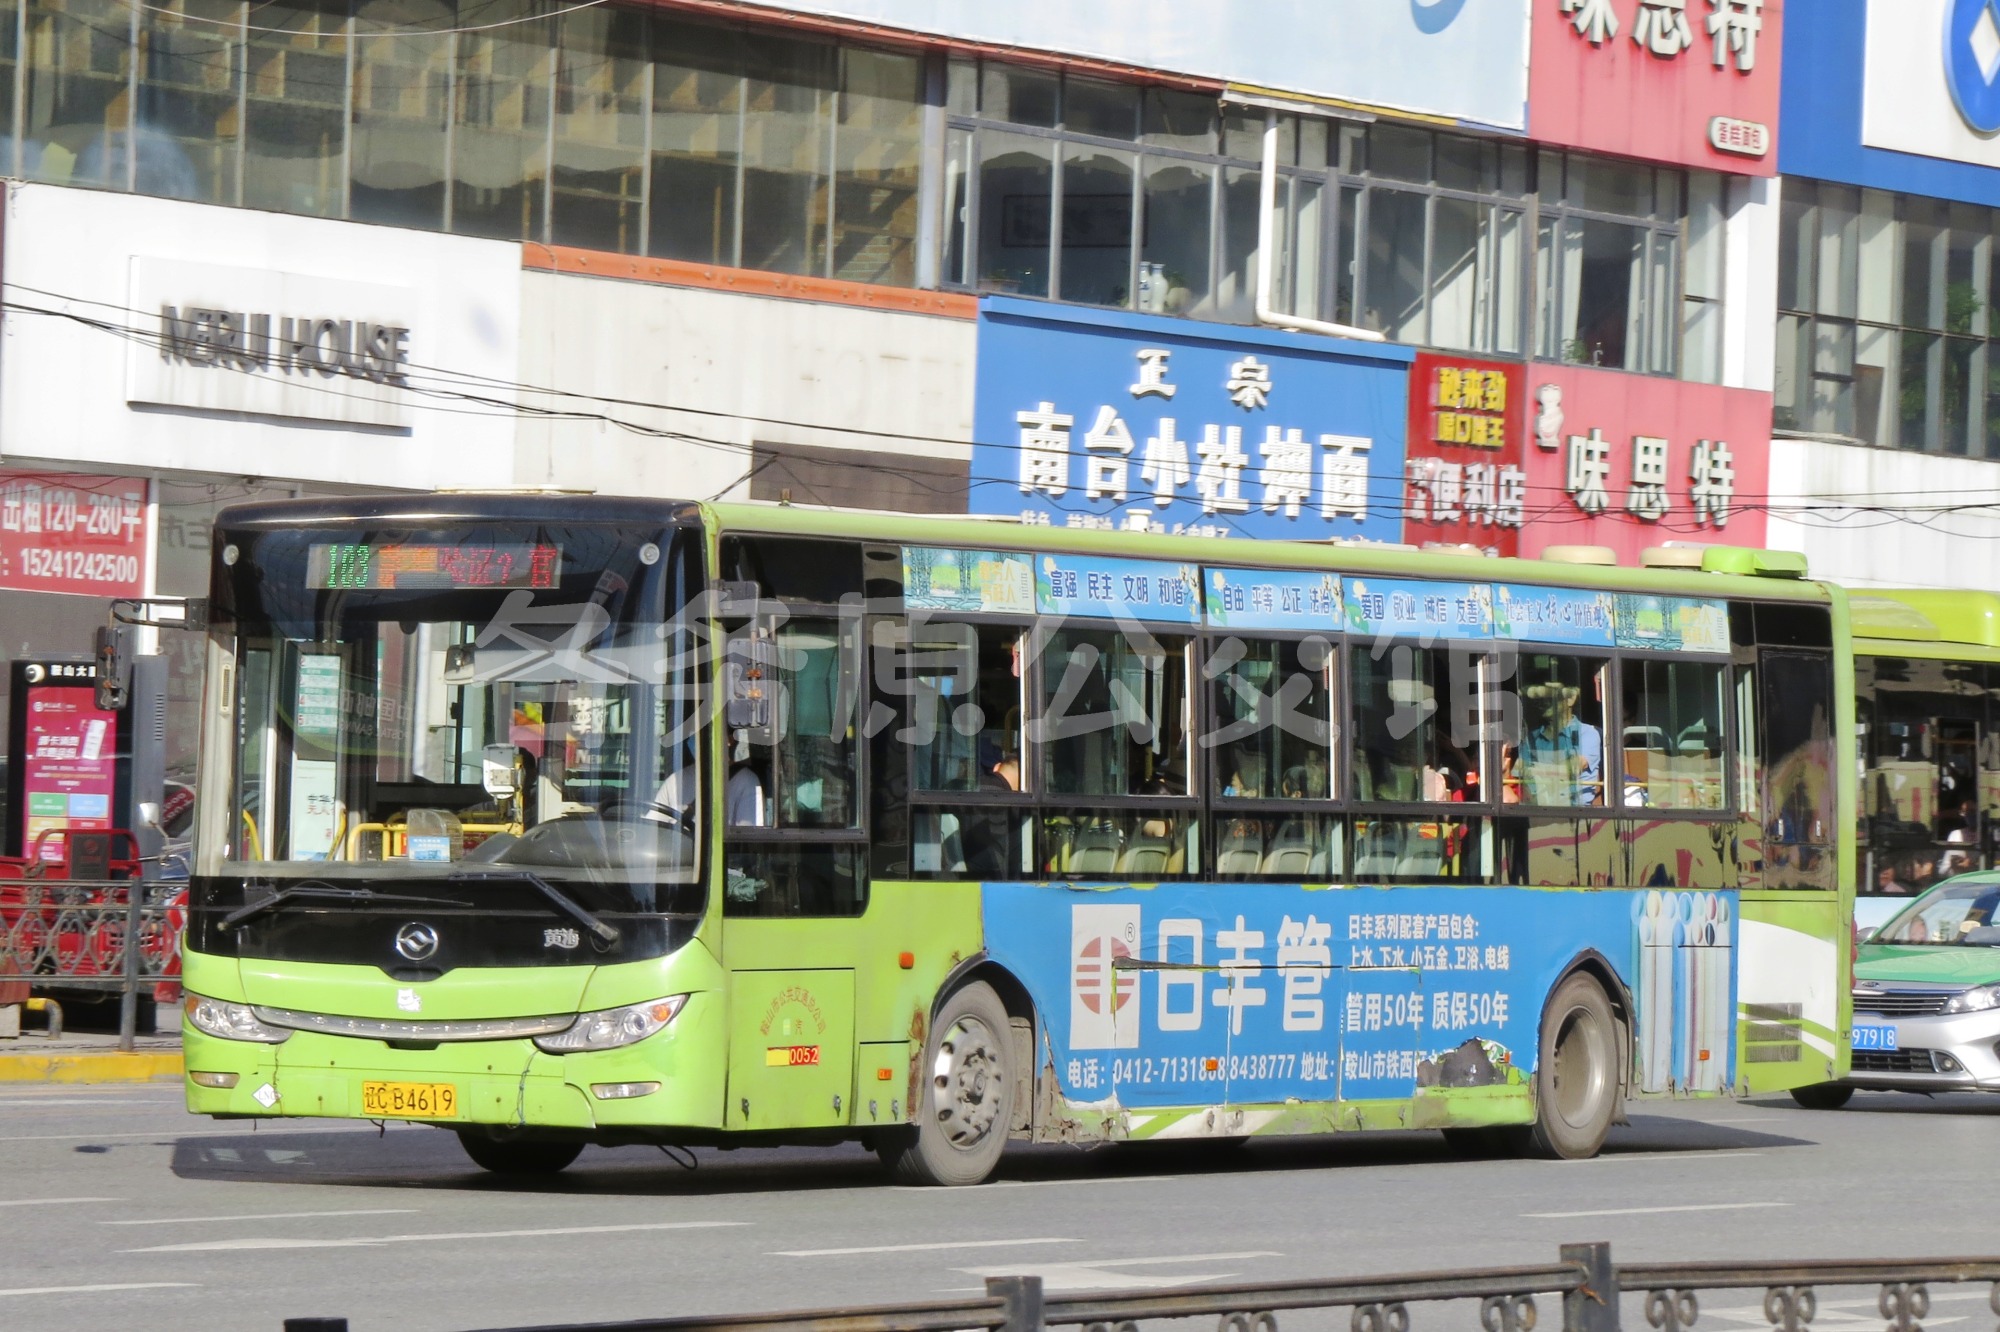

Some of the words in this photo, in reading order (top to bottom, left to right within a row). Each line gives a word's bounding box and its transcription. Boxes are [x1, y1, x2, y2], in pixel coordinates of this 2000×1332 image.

[279, 317, 410, 381] HOUSE
[1129, 348, 1272, 409] 正宗
[1566, 427, 1735, 527] 味思特
[20, 548, 138, 583] 15241242500
[327, 545, 370, 588] 103
[1050, 569, 1077, 601] 富强
[1087, 572, 1114, 602] 民主
[1122, 575, 1149, 603] 文明
[1158, 577, 1184, 607] 和谐
[1222, 584, 1245, 613] 自由
[1251, 585, 1274, 614] 平等
[1281, 586, 1303, 614] 公正
[1309, 587, 1331, 616] 法治
[1361, 592, 1384, 621] 爱国
[1392, 594, 1416, 623] 敬业
[1423, 594, 1447, 623] 诚信
[1455, 595, 1479, 625] 友善
[1504, 592, 1603, 630] 社会主义核心价值观
[543, 927, 580, 949] 黄海
[1347, 913, 1480, 941] 日丰系列配套产品包含:
[1158, 914, 1331, 1036] 日丰管
[1345, 990, 1425, 1033] 管用50年
[1431, 989, 1510, 1032] 质保50年
[789, 1047, 819, 1064] 0052
[1067, 1057, 1106, 1089] 电话:
[1230, 1053, 1296, 1081] 8438777
[1300, 1053, 1334, 1081] 地址:
